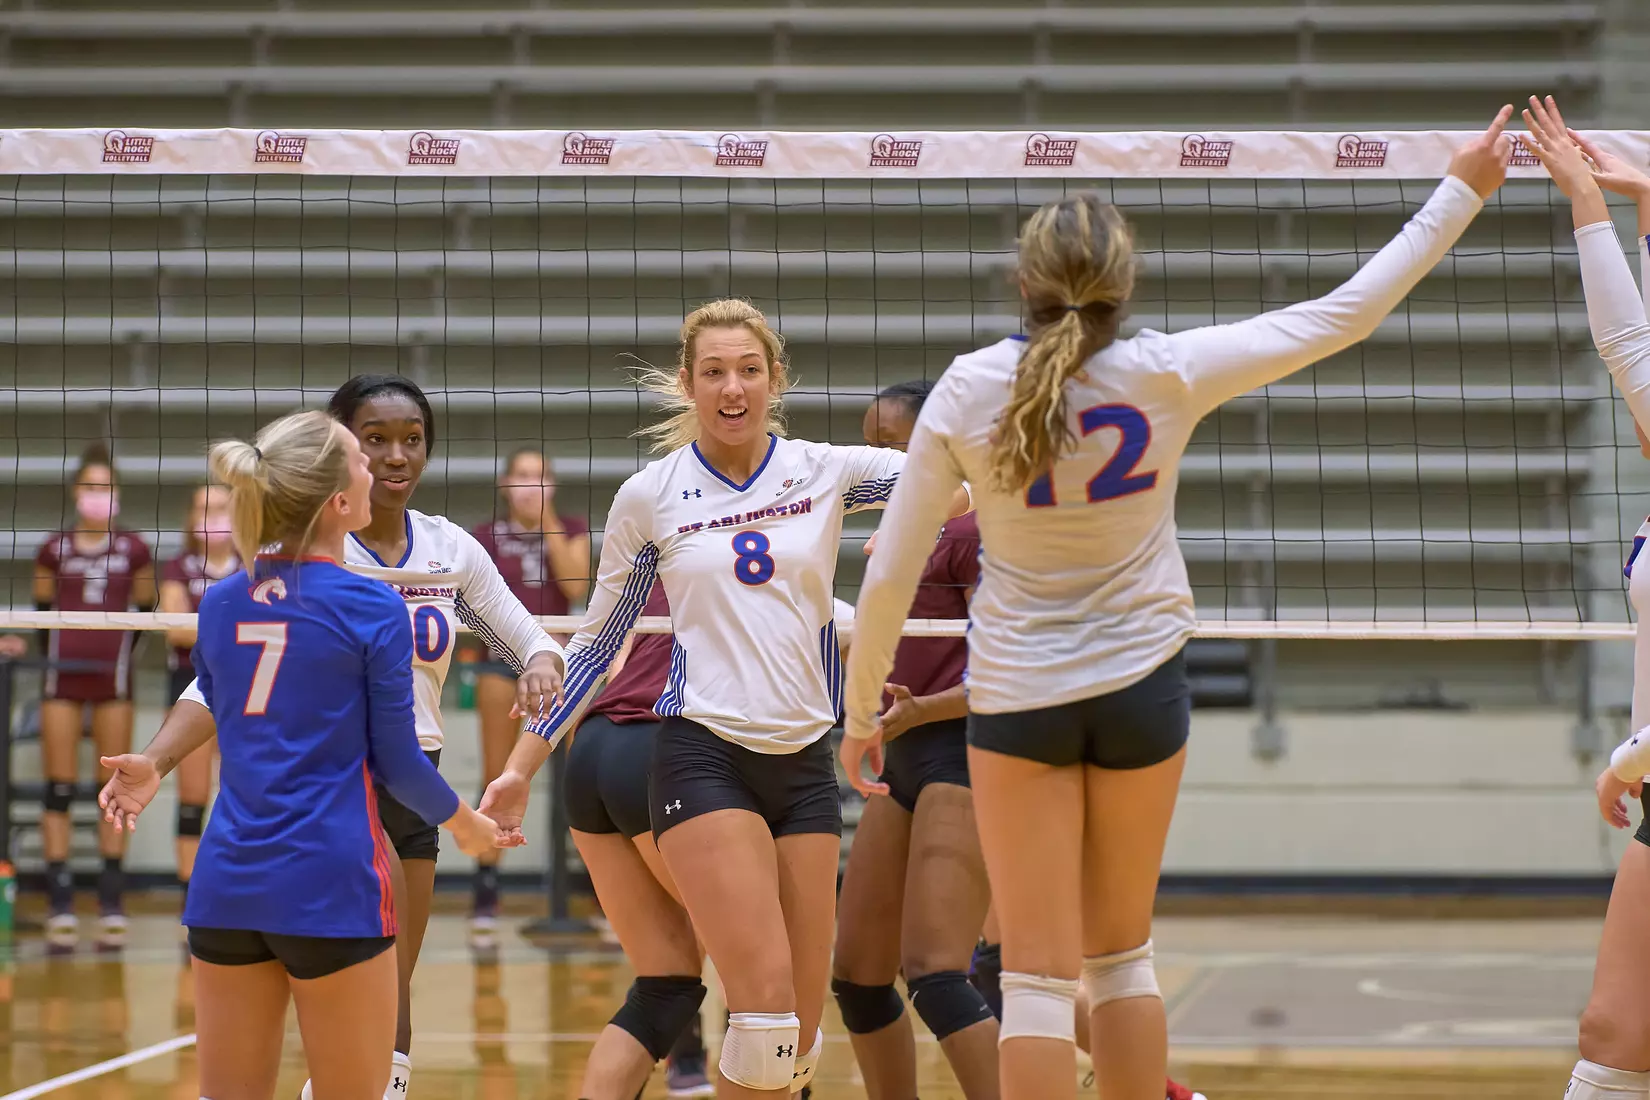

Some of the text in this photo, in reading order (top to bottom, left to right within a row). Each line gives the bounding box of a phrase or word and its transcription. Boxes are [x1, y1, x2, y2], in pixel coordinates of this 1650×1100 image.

[126, 138, 152, 146] LITTLE
[278, 138, 305, 146] LITTLE
[431, 140, 459, 148] LITTLE
[585, 140, 612, 148] LITTLE
[739, 142, 766, 150] LITTLE
[893, 142, 921, 150] LITTLE
[1048, 141, 1076, 149] LITTLE
[1204, 142, 1231, 150] LITTLE
[1359, 142, 1387, 150] LITTLE
[737, 149, 764, 157] ROCK
[891, 149, 919, 157] ROCK
[1202, 149, 1229, 157] ROCK
[731, 529, 776, 586] 8
[236, 621, 288, 716] 7
